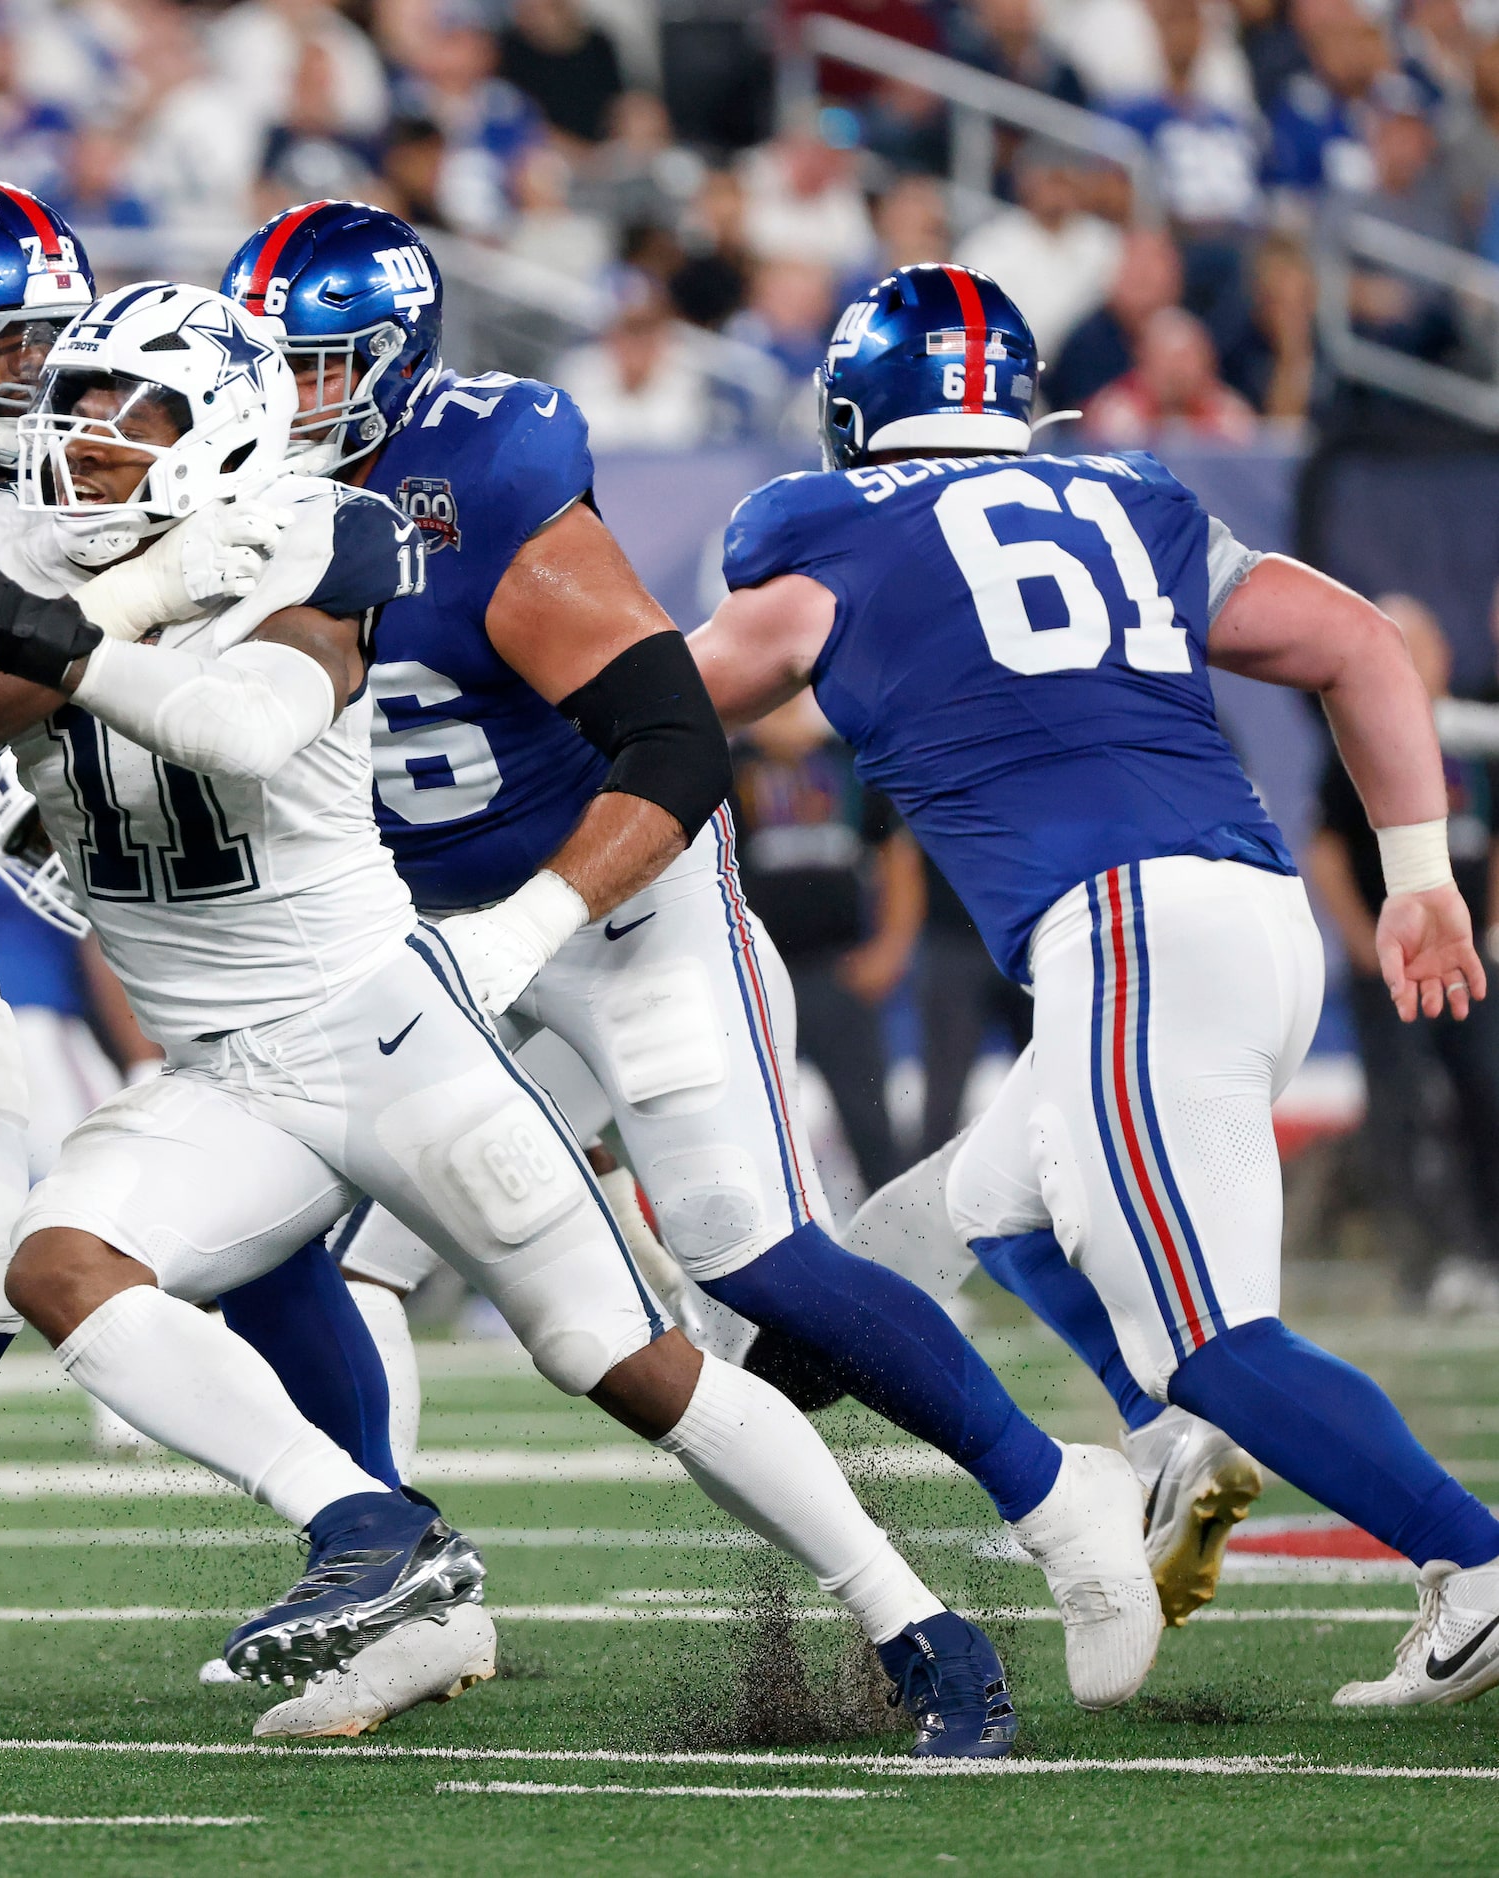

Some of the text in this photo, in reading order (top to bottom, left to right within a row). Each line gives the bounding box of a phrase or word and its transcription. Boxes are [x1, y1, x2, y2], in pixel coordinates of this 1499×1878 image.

[19, 235, 80, 274] 78
[58, 341, 100, 352] WBOYS
[943, 363, 997, 402] 61
[398, 491, 453, 524] 100
[415, 520, 450, 532] ASONS
[395, 543, 427, 598] 11
[933, 468, 1193, 676] 61
[45, 702, 260, 902] 11
